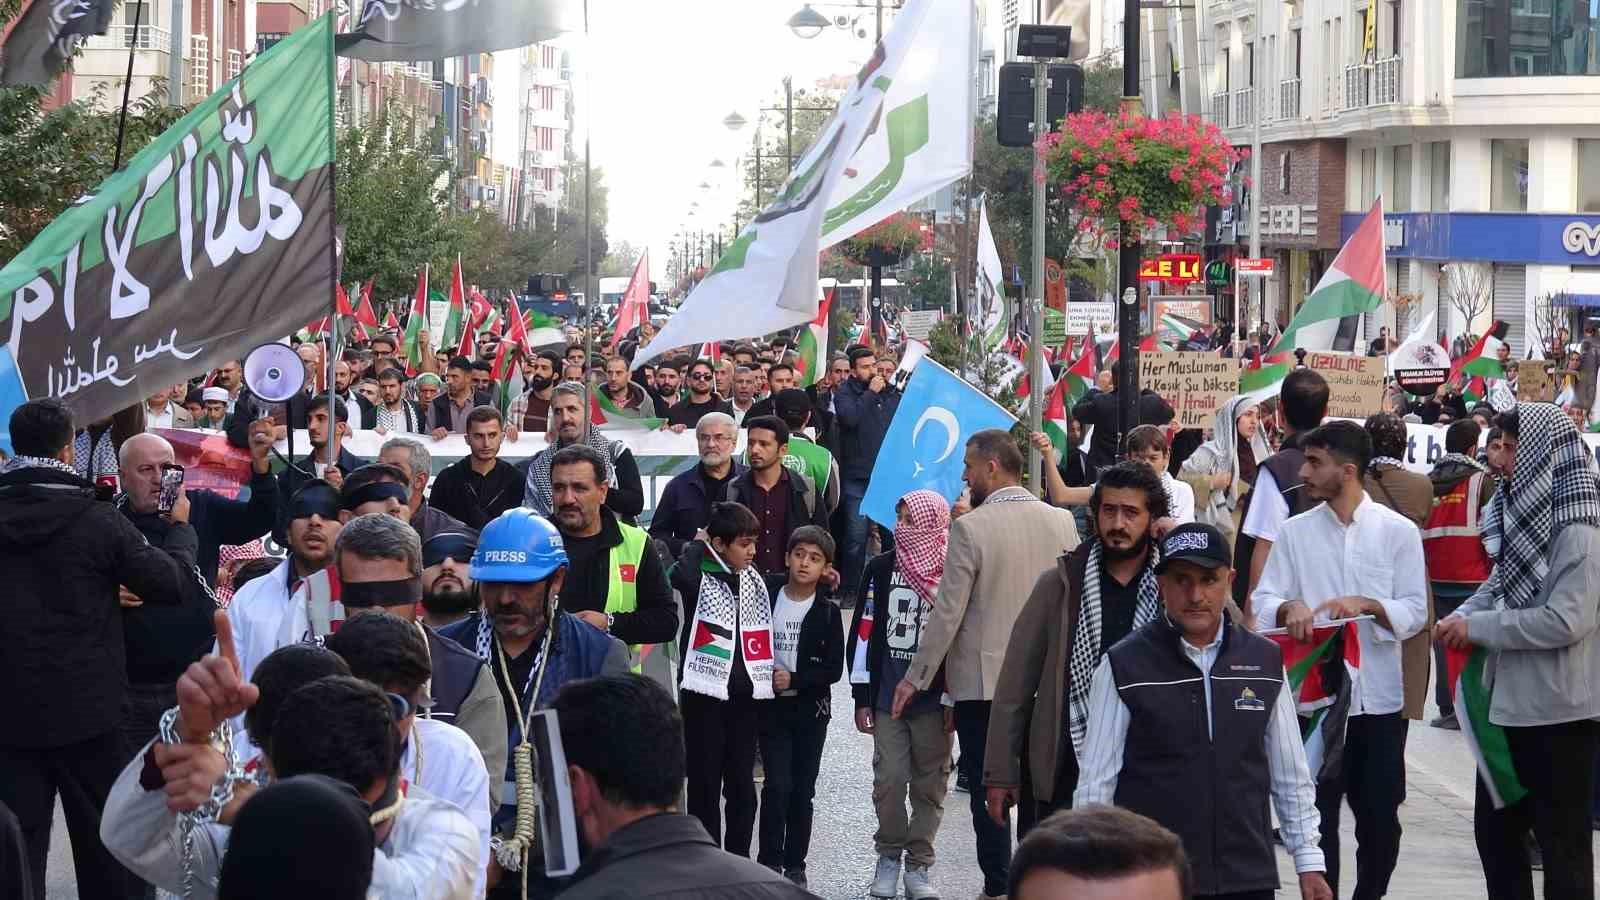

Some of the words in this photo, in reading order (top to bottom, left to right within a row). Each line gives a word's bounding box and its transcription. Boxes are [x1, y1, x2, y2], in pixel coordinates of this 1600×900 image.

[1142, 361, 1166, 376] Her
[1184, 377, 1199, 392] Su
[484, 550, 527, 563] PRESS
